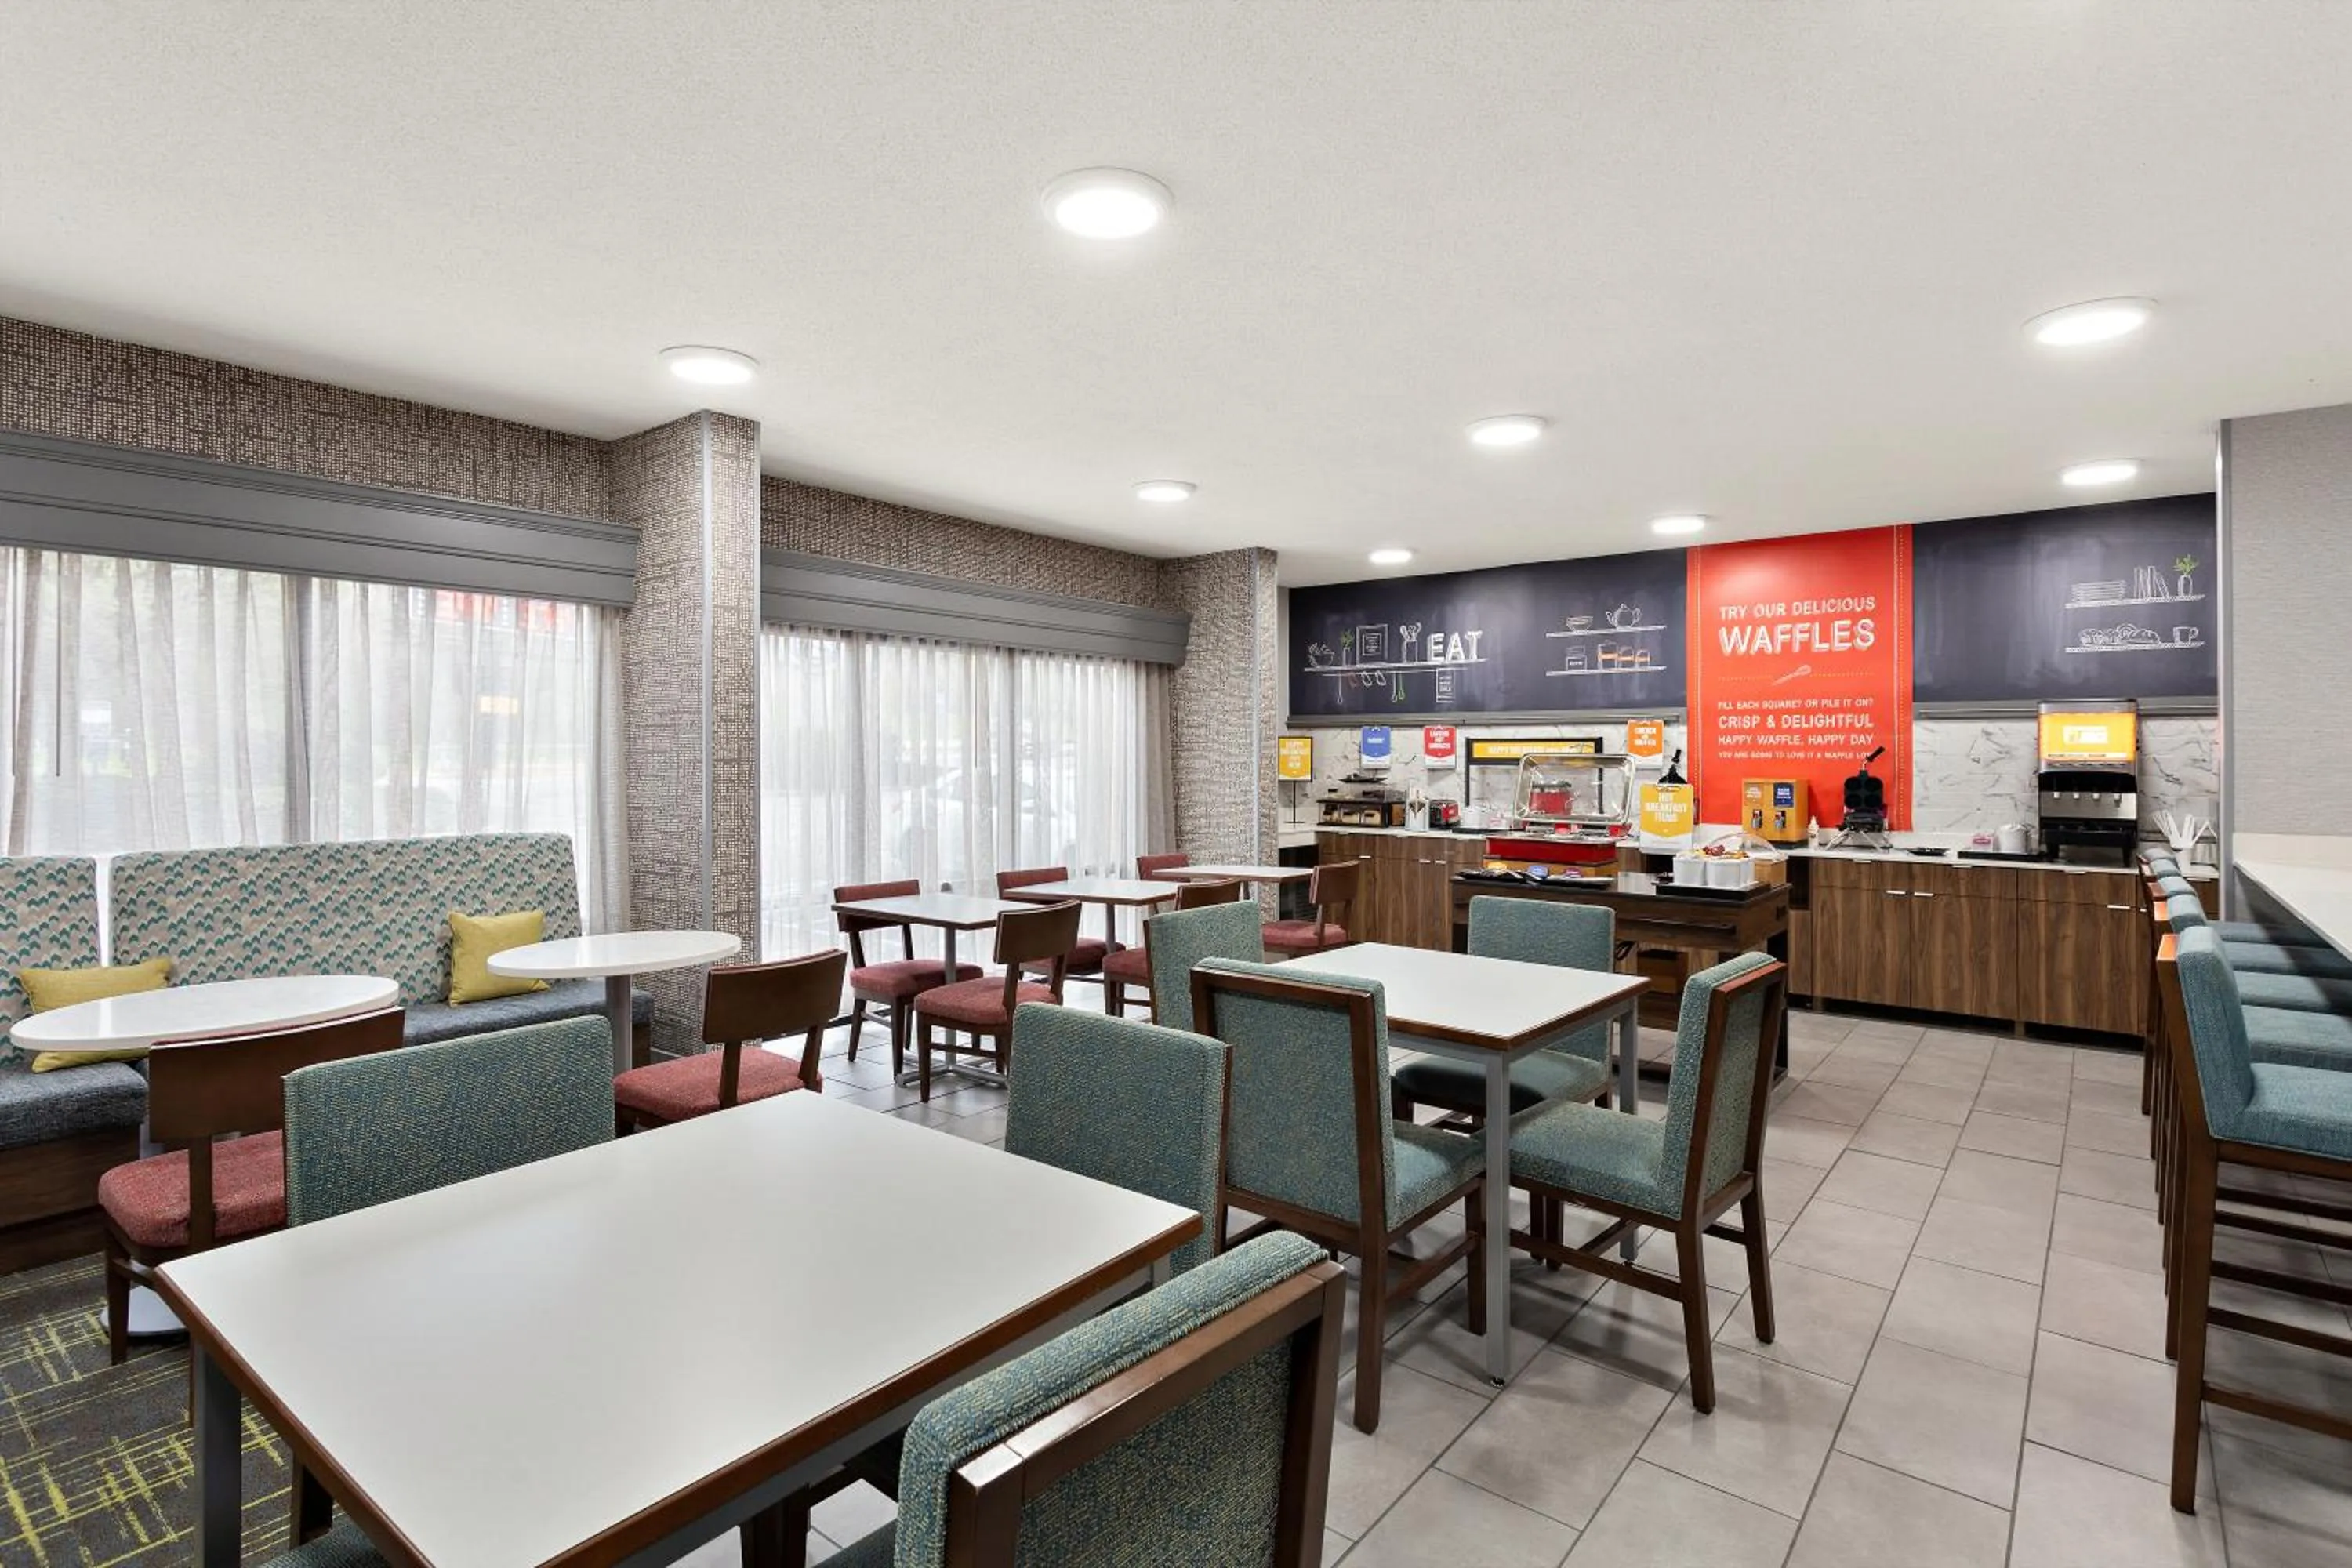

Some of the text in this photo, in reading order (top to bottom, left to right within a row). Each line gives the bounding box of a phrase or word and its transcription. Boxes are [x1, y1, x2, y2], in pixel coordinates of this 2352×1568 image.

[1719, 596, 1875, 620] TRY OUR DELICIOUS
[1427, 630, 1483, 662] EAT
[1719, 618, 1875, 656] WAFFLES
[1737, 700, 1759, 710] EACH
[1762, 699, 1802, 710] SQUARE?
[1806, 699, 1819, 709] OR
[1821, 699, 1840, 708] PILE
[1843, 698, 1852, 708] IT
[1856, 697, 1874, 707] ON?
[1718, 713, 1875, 729] CRISP & DELIGHTFUL
[1718, 735, 1752, 746] HAPPY
[1808, 734, 1846, 746] HAPPY
[1850, 733, 1874, 745] DAY
